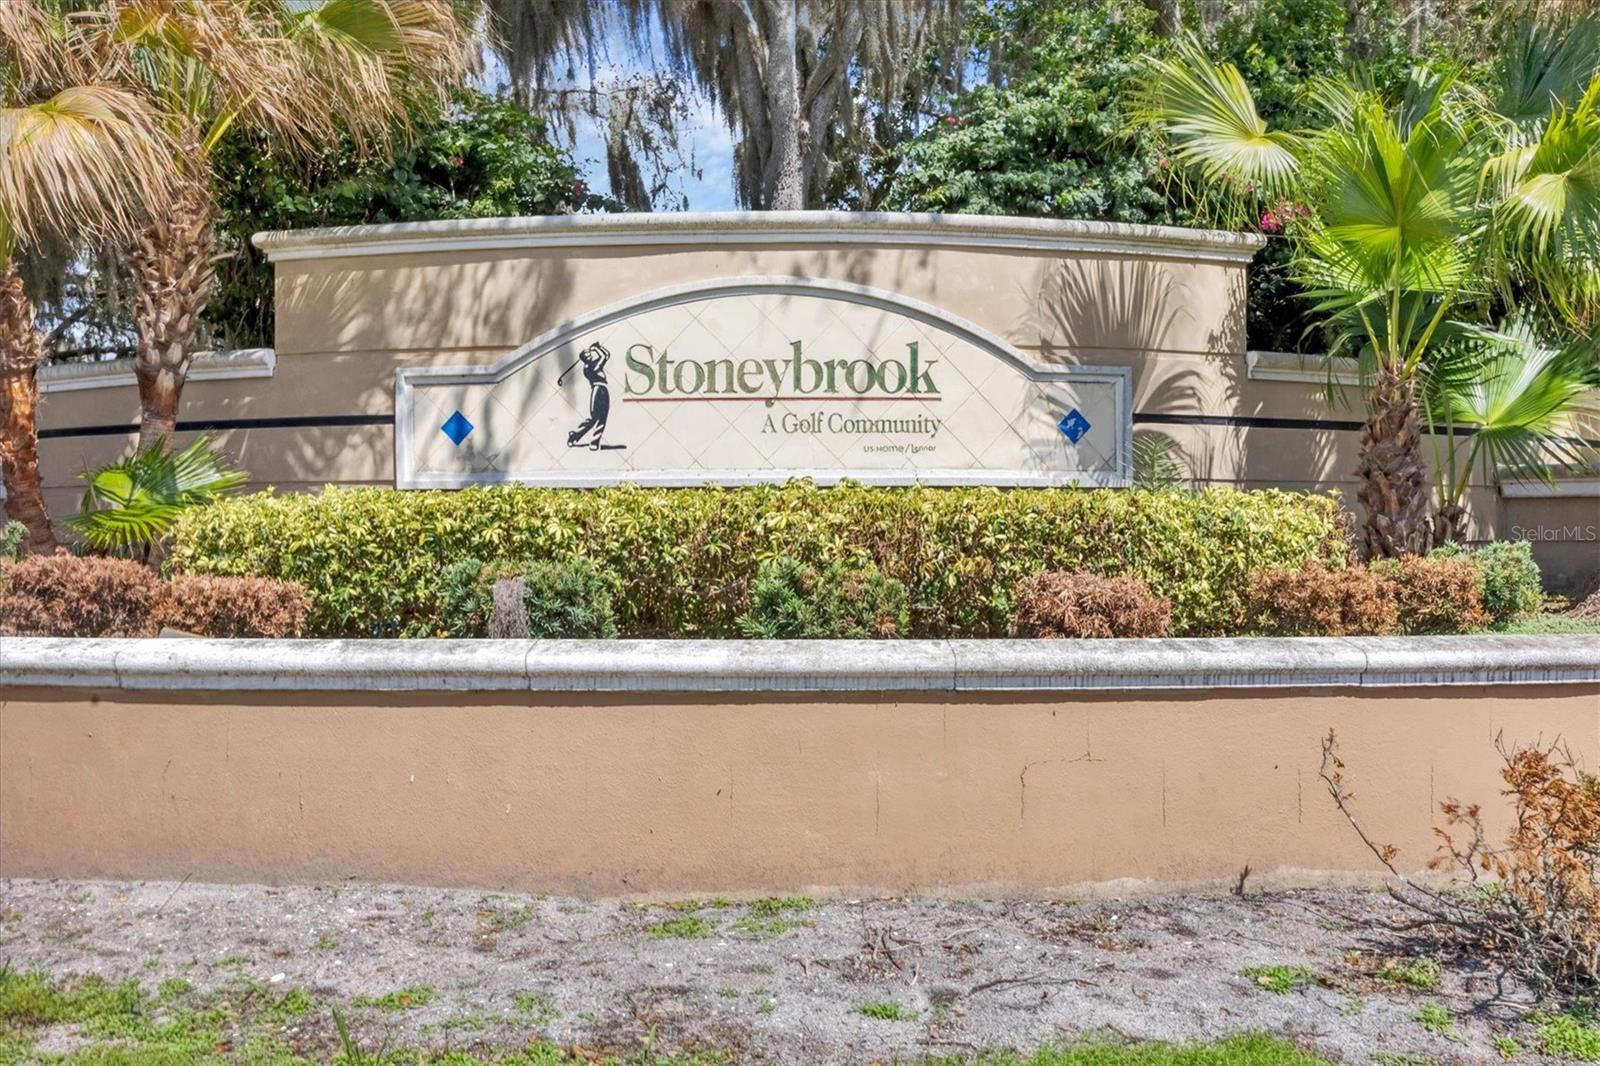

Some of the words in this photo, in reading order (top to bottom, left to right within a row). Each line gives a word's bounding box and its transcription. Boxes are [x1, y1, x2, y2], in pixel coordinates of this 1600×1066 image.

[623, 340, 941, 408] Stoneybrook
[761, 413, 777, 434] A
[782, 411, 824, 434] Golf
[827, 412, 942, 439] Community
